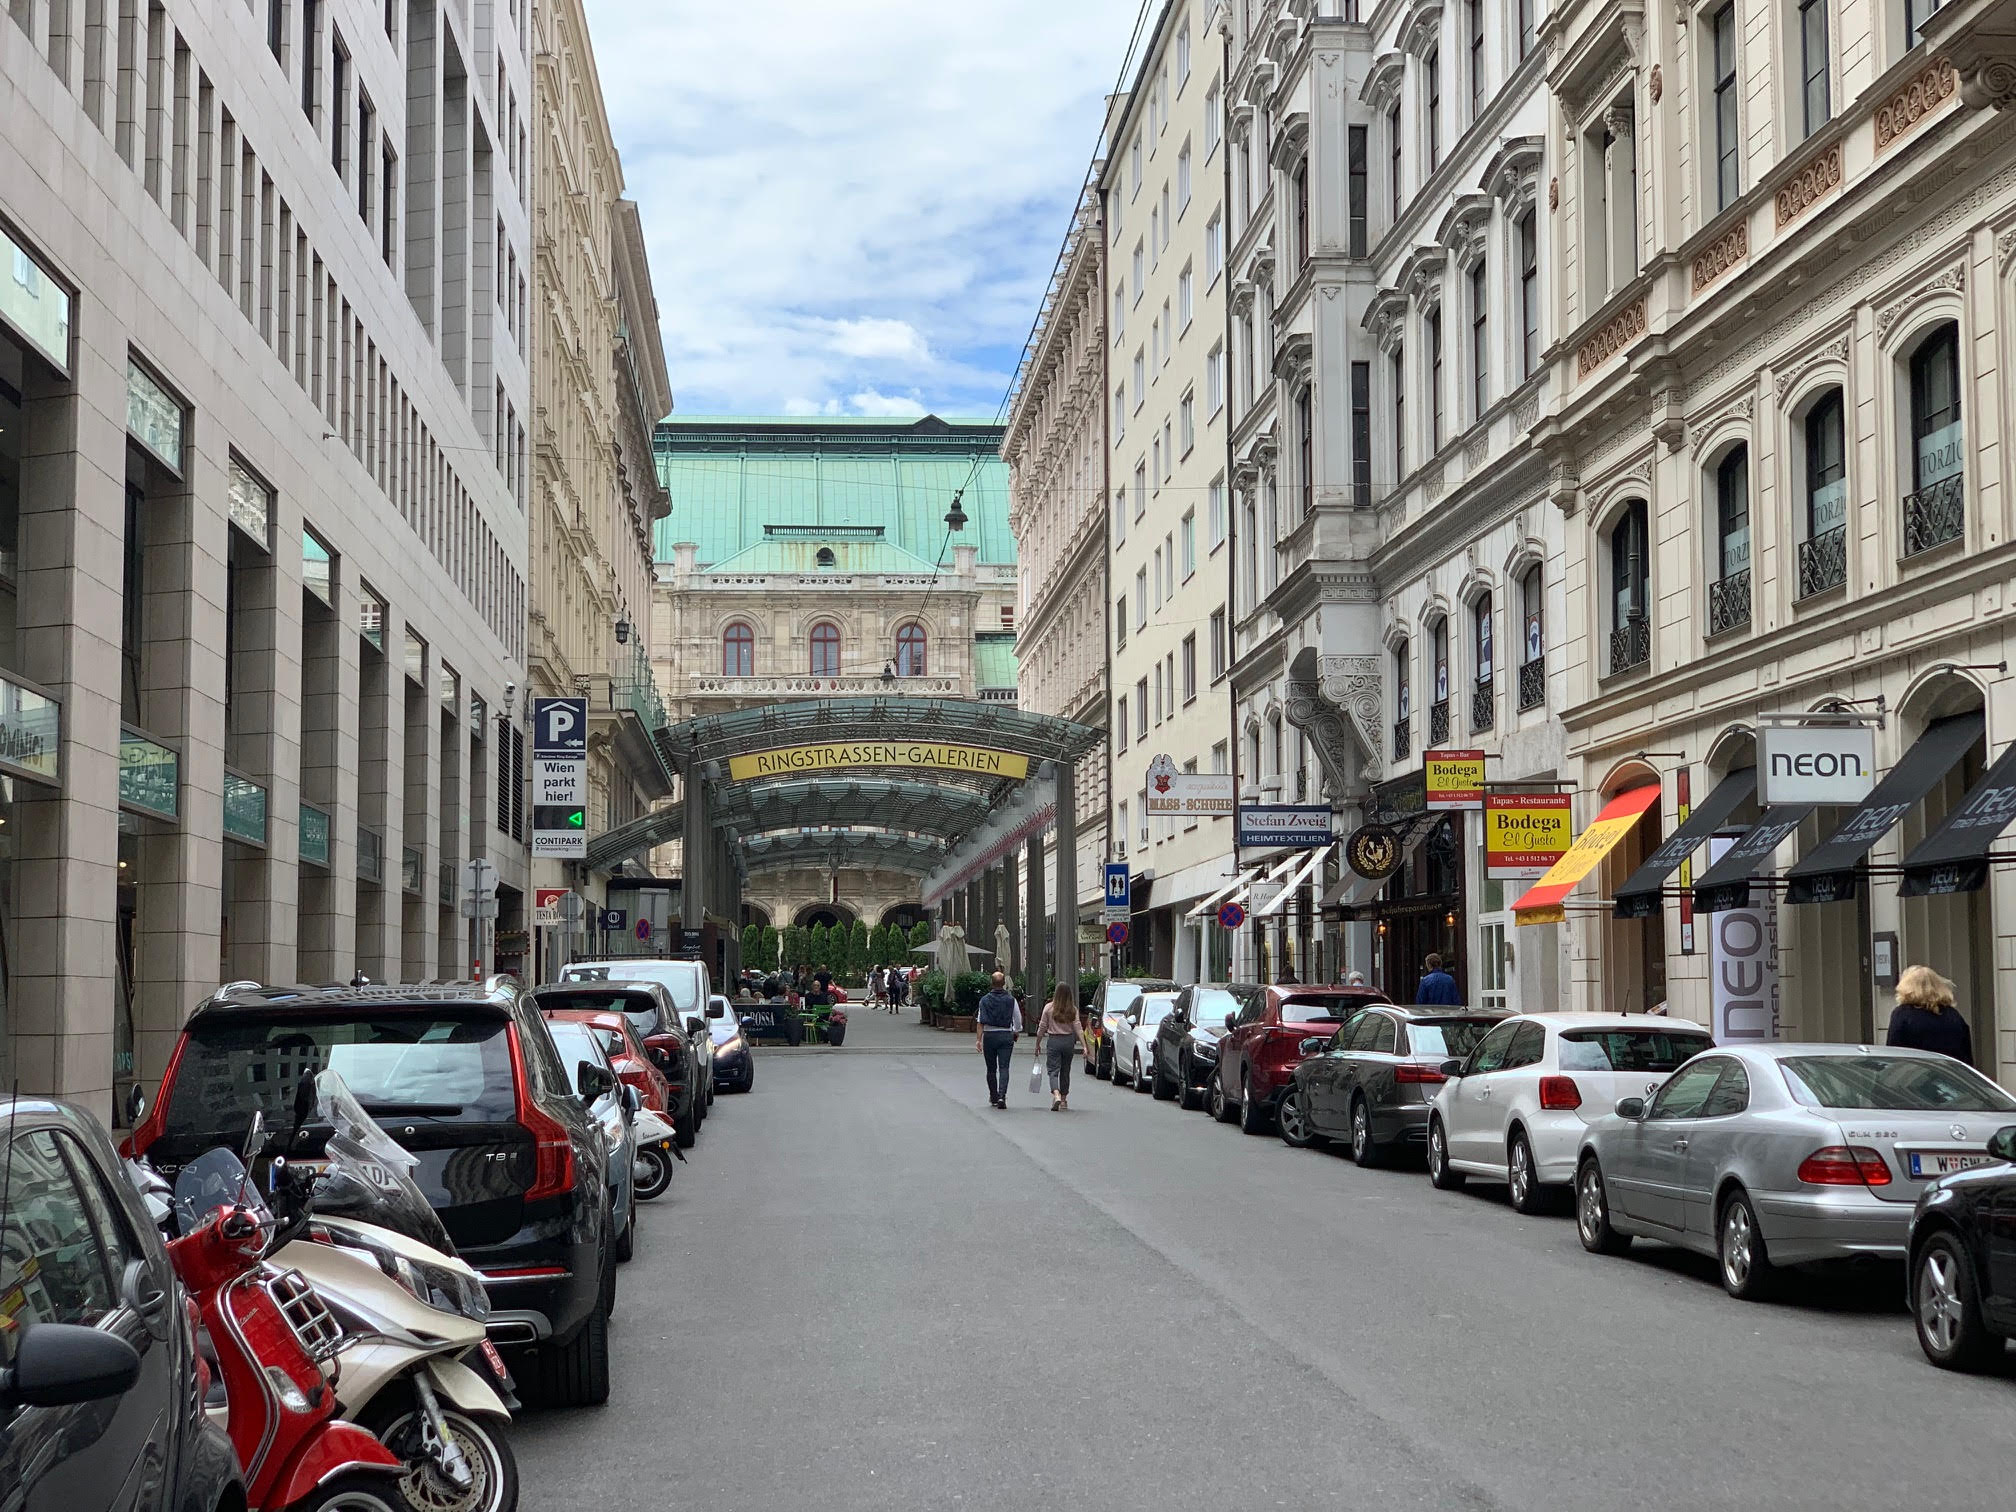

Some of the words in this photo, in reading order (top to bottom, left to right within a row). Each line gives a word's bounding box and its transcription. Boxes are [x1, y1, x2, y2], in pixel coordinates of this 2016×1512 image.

[1814, 495, 1847, 526] TORZI
[549, 711, 575, 742] P
[758, 746, 1001, 773] RINGSTRASSEN-GALERIEN
[544, 762, 575, 773] Wien
[1433, 764, 1478, 777] Bodega
[544, 777, 576, 790] parkt
[1437, 777, 1450, 787] El
[545, 791, 573, 803] hier!
[1492, 797, 1514, 806] Tapas
[1520, 797, 1566, 805] Restaurante
[1246, 814, 1286, 827] Stefan
[1287, 814, 1327, 829] Zweig
[1497, 814, 1561, 833] Bodega
[535, 837, 583, 845] CONTIPARK
[1503, 831, 1520, 847] El
[1524, 831, 1556, 850] Gusto
[1770, 983, 1780, 1038] men
